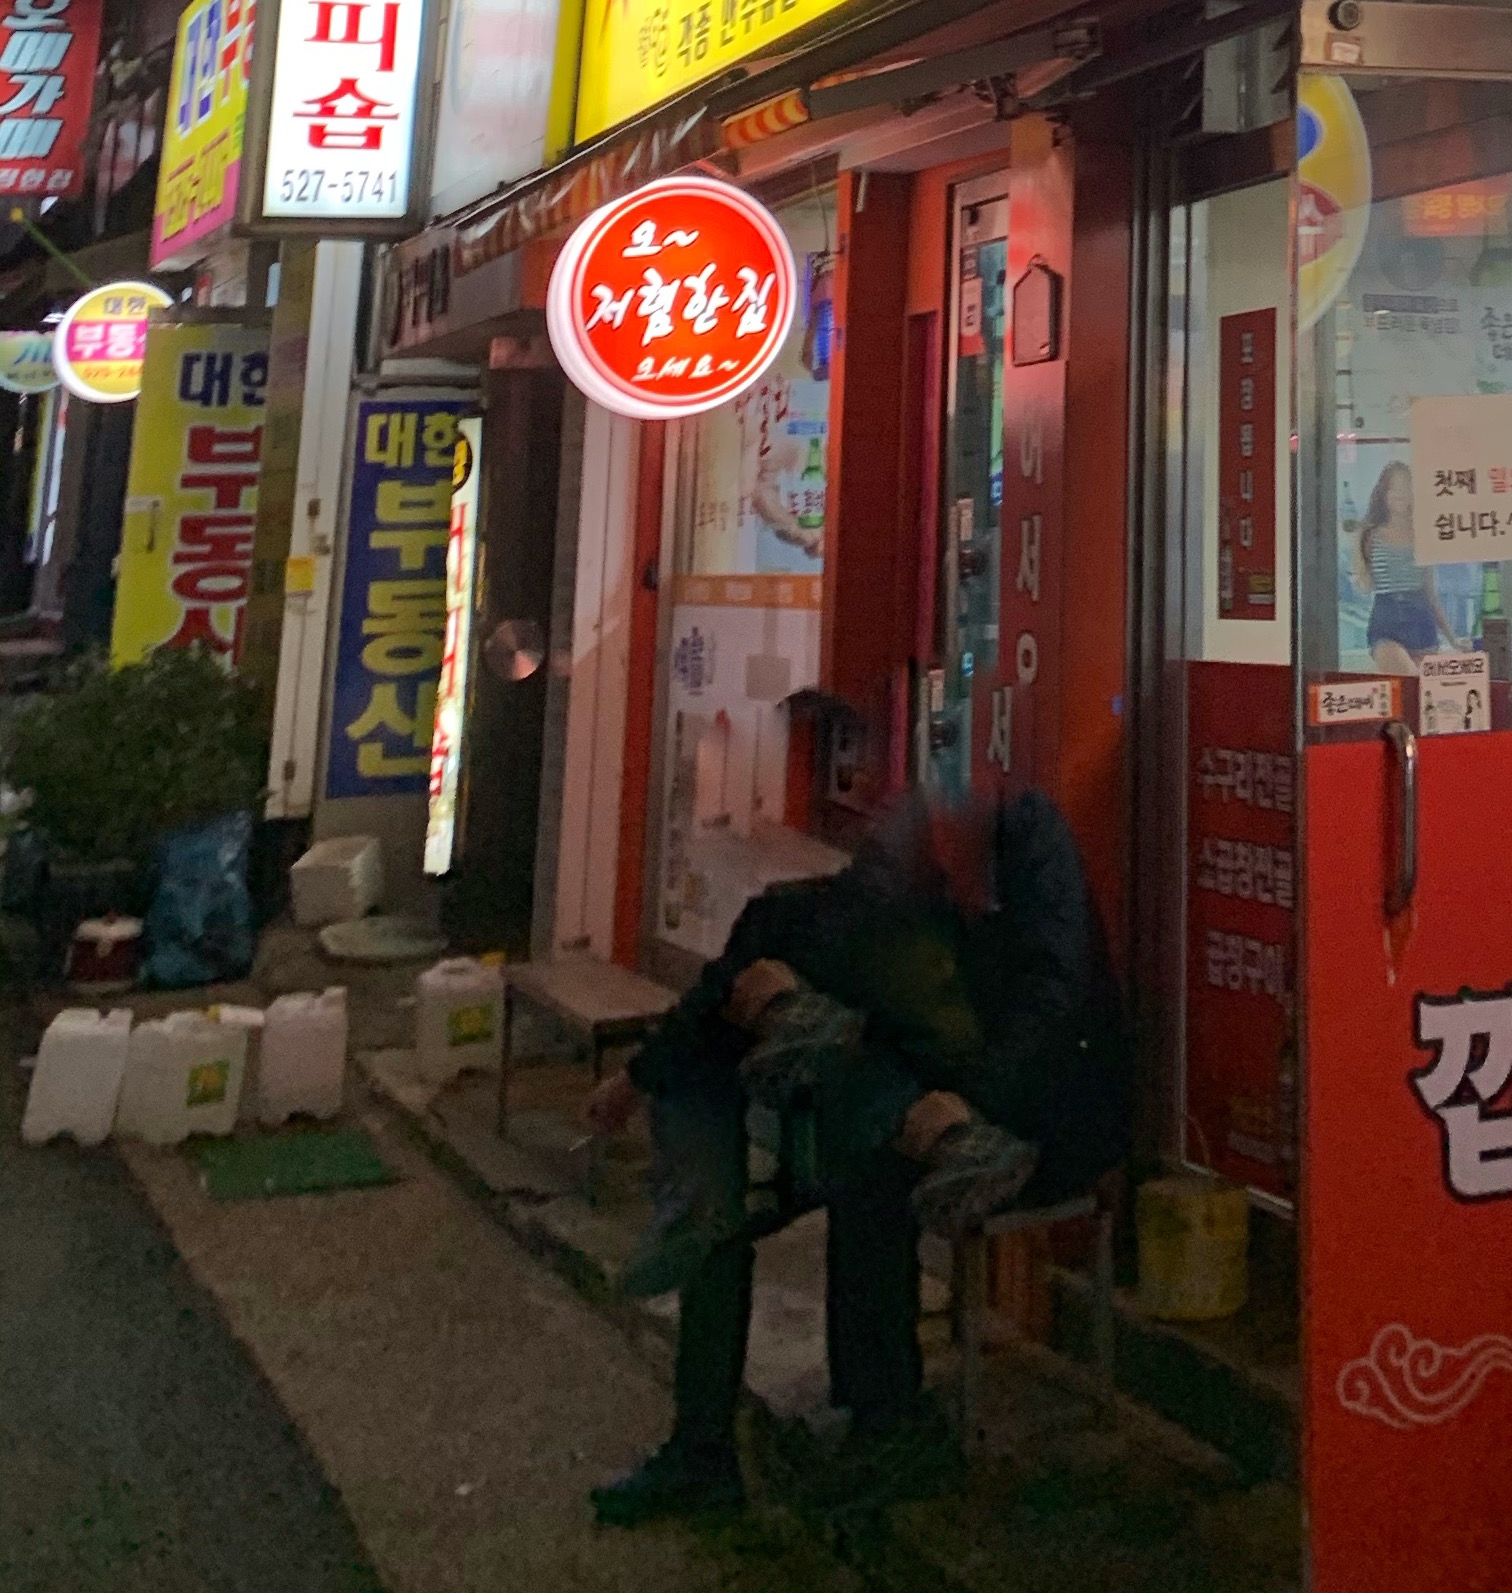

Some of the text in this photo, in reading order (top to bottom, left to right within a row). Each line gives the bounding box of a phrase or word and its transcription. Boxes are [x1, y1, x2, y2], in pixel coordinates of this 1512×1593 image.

[279, 168, 399, 204] 527-5741
[584, 262, 777, 348] 저렴한집
[71, 322, 147, 359] 부동
[1433, 467, 1478, 497] 첫째
[345, 479, 451, 780] 부동산
